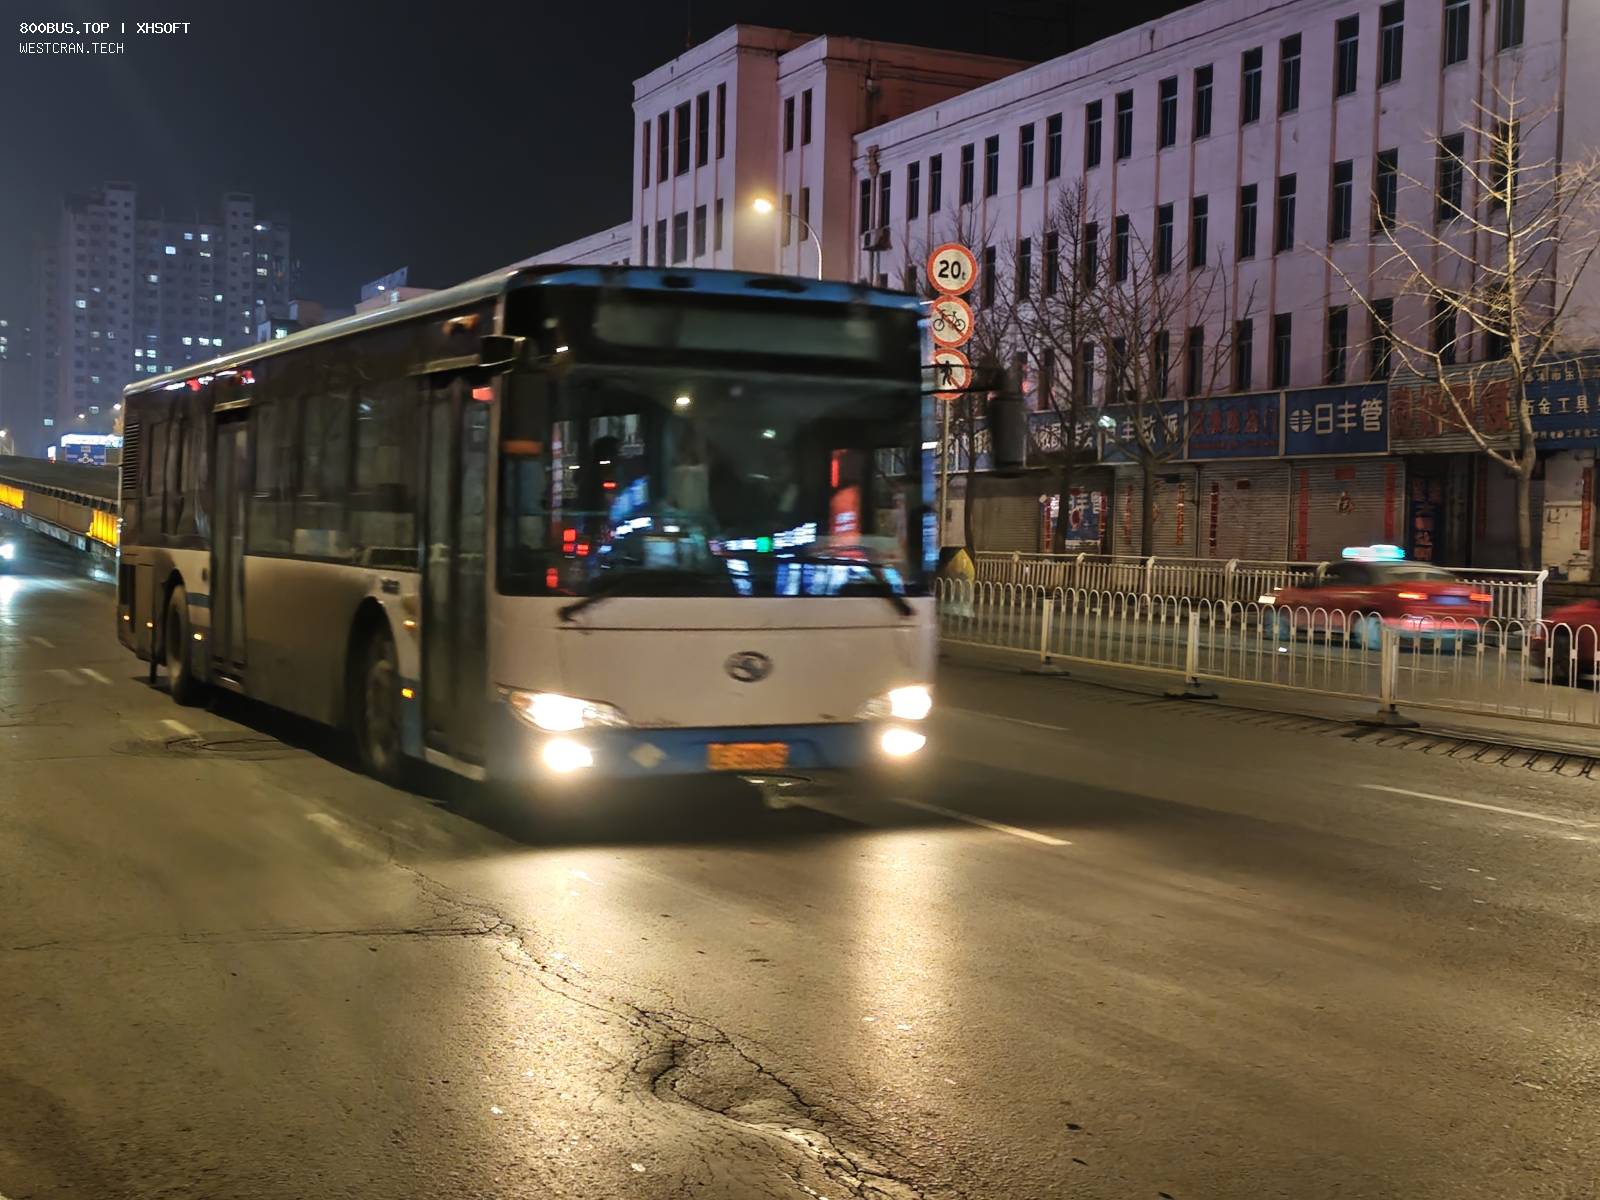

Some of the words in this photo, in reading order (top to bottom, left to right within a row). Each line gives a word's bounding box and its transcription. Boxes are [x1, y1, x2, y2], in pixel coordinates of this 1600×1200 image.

[1315, 399, 1383, 434] 日丰管
[1527, 394, 1600, 416] 金工具
